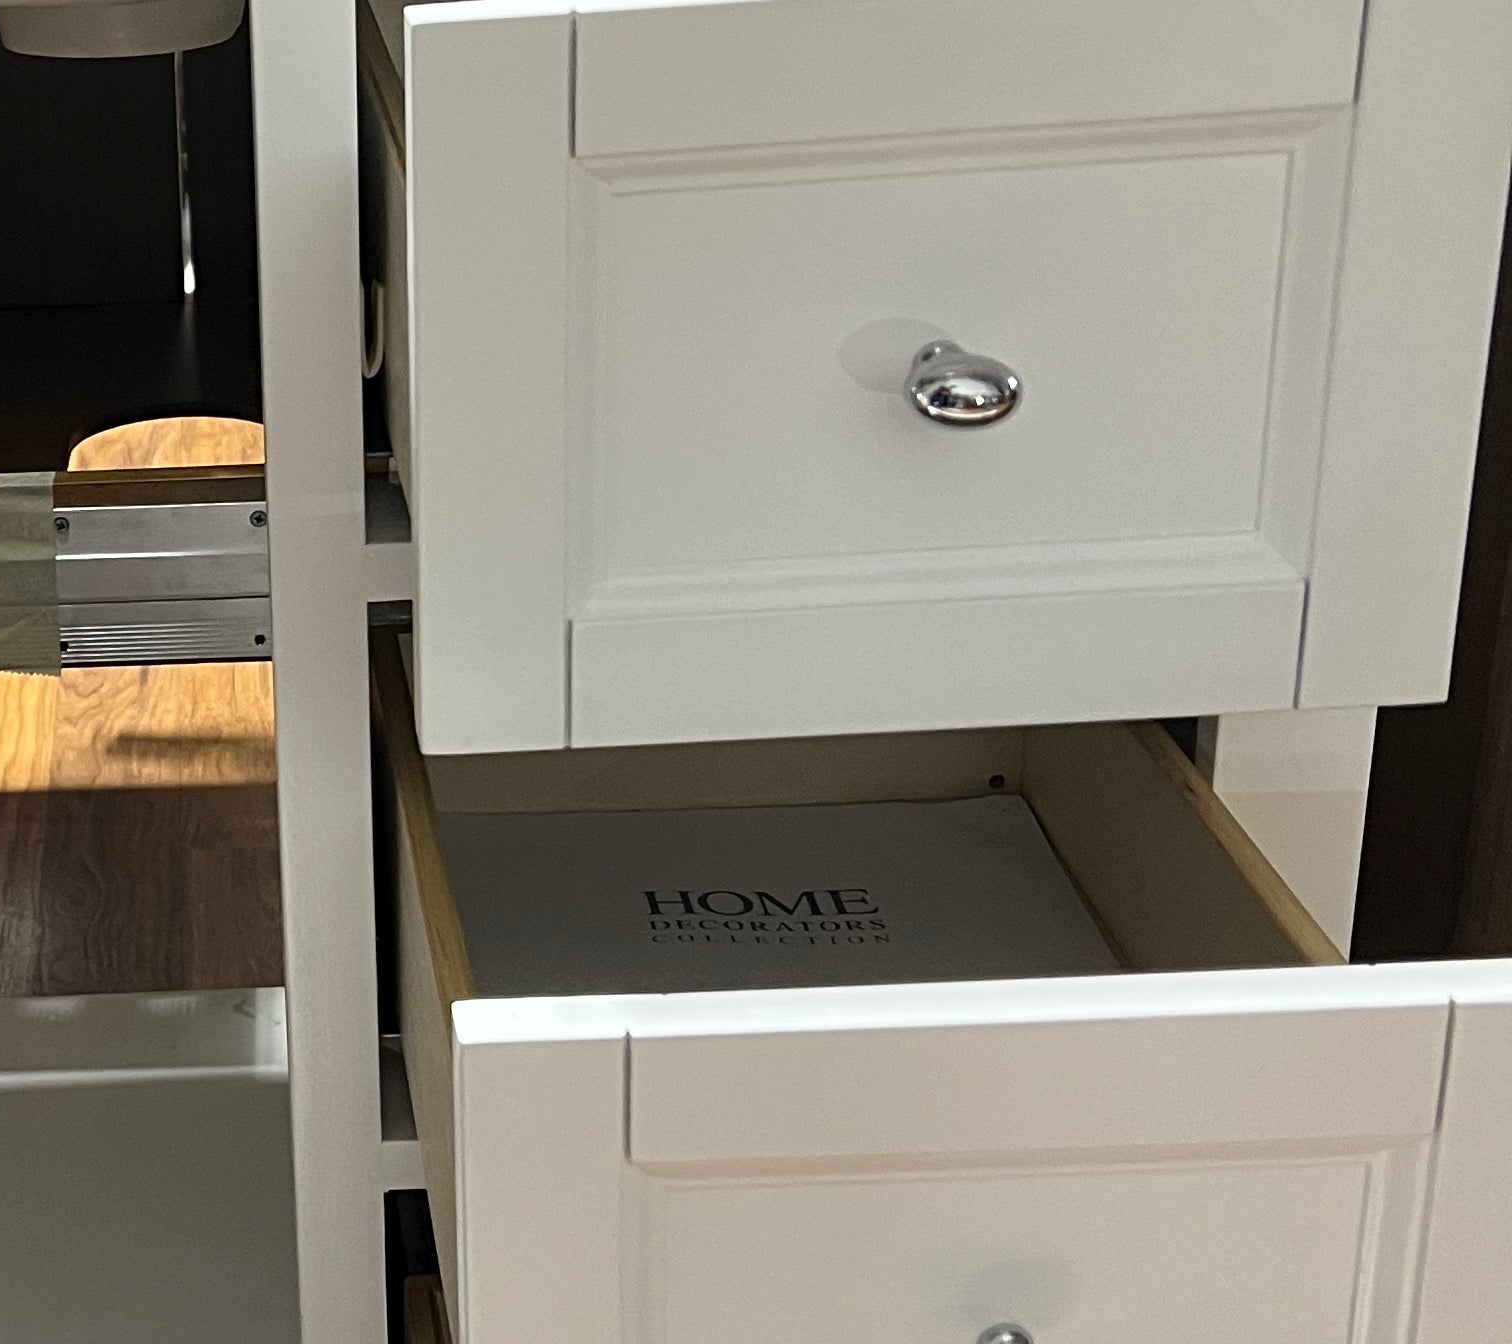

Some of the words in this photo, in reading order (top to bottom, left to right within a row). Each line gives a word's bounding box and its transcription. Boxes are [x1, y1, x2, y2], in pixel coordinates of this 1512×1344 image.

[642, 888, 880, 916] HOME
[649, 918, 886, 932] DECORATORS
[651, 934, 891, 945] COLLECTION
